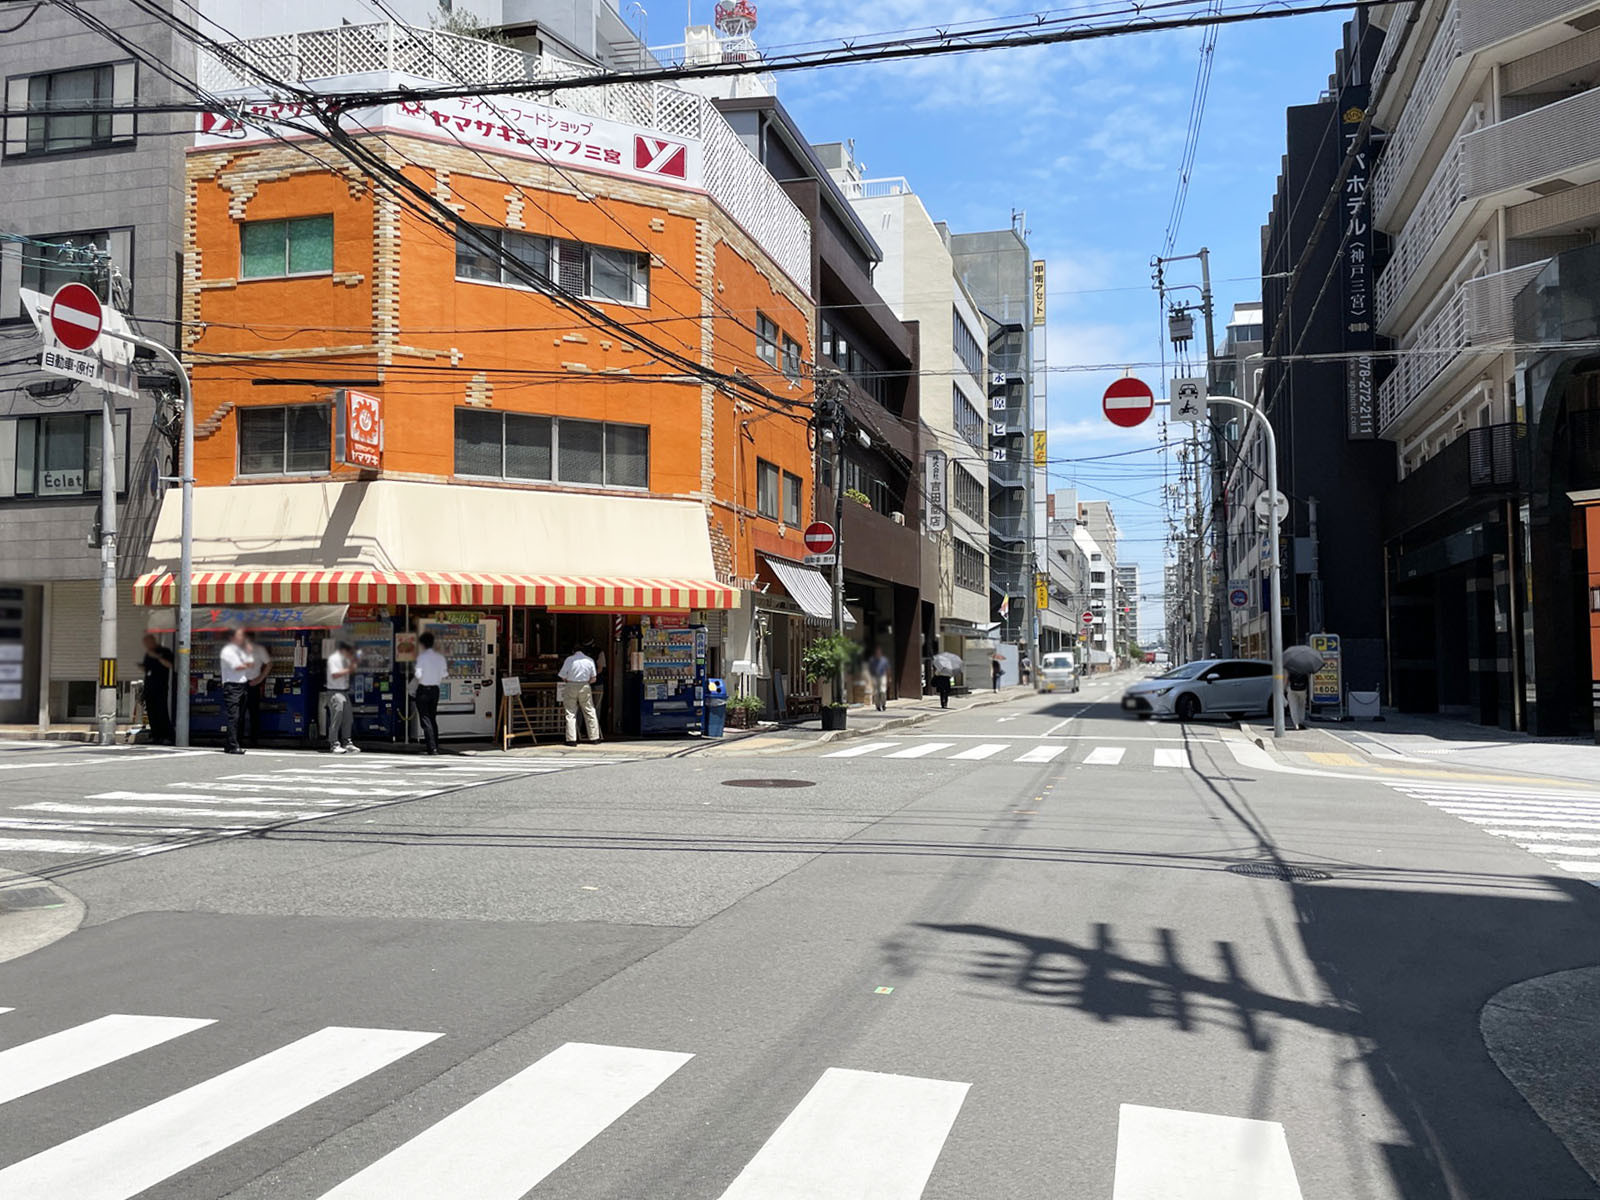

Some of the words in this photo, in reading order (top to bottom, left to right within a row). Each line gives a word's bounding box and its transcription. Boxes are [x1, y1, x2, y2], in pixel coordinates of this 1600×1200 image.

[45, 352, 95, 378] 自動車・原付
[1358, 355, 1373, 433] 078-272-2111
[44, 472, 83, 488] Éclat
